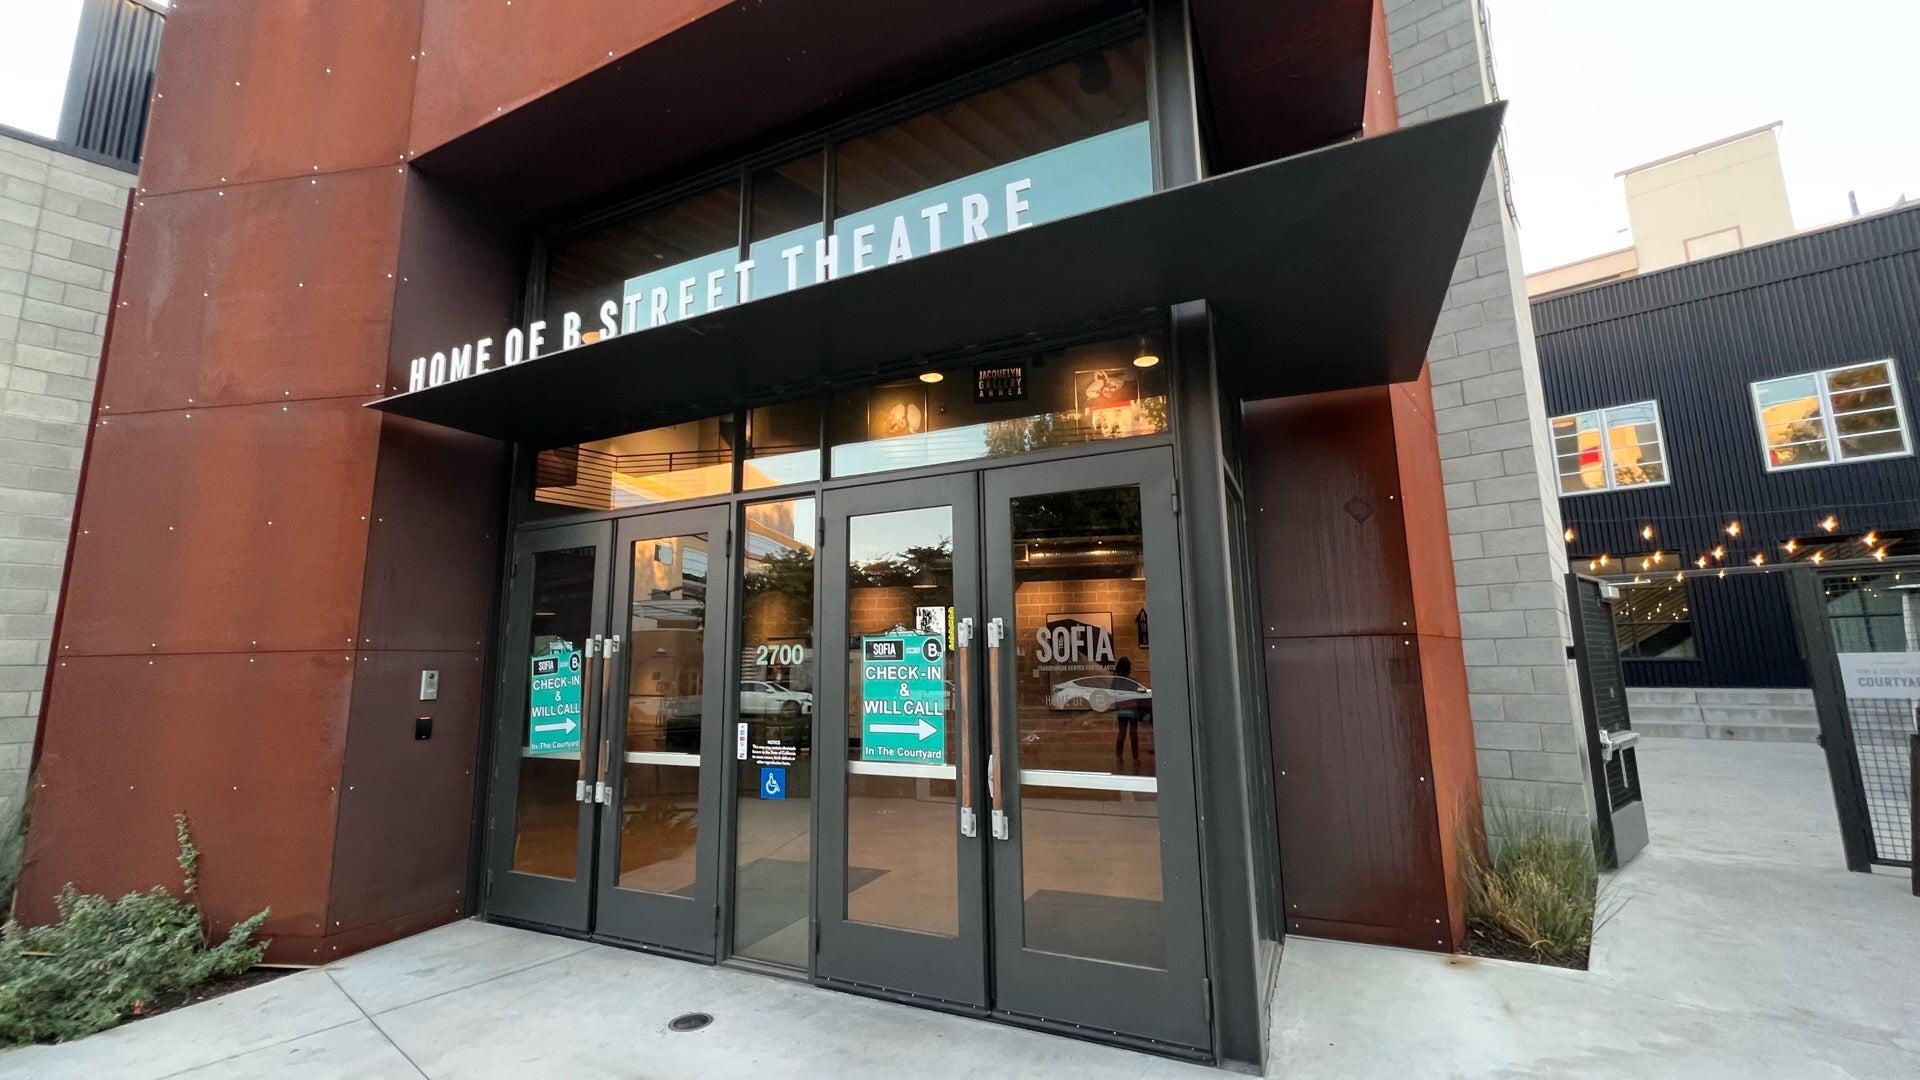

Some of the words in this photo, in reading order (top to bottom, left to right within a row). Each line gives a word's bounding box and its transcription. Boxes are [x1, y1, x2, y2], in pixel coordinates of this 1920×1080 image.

[409, 337, 493, 393] HOME
[504, 320, 546, 364] OF
[562, 312, 582, 350] B
[600, 259, 755, 341] STREET
[781, 178, 1034, 291] THEATRE
[978, 367, 1022, 380] JACQUELYN
[978, 377, 1022, 390] GALLERY
[873, 642, 896, 656] SOFIA
[928, 642, 938, 658] B
[1036, 626, 1114, 663] SOFIA
[755, 644, 804, 666] 2700
[538, 660, 554, 672] SOFIA
[865, 666, 941, 680] CHECK-IN
[533, 676, 580, 690] CHECK-IN
[899, 683, 910, 697] &
[555, 690, 562, 701] &
[532, 705, 556, 717] WILL
[557, 703, 580, 715] CALL
[864, 701, 901, 715] WILL
[903, 701, 943, 716] CALL
[552, 740, 579, 749] Courtyard
[865, 746, 874, 755] In
[877, 746, 894, 756] The
[897, 747, 941, 760] Courtyard
